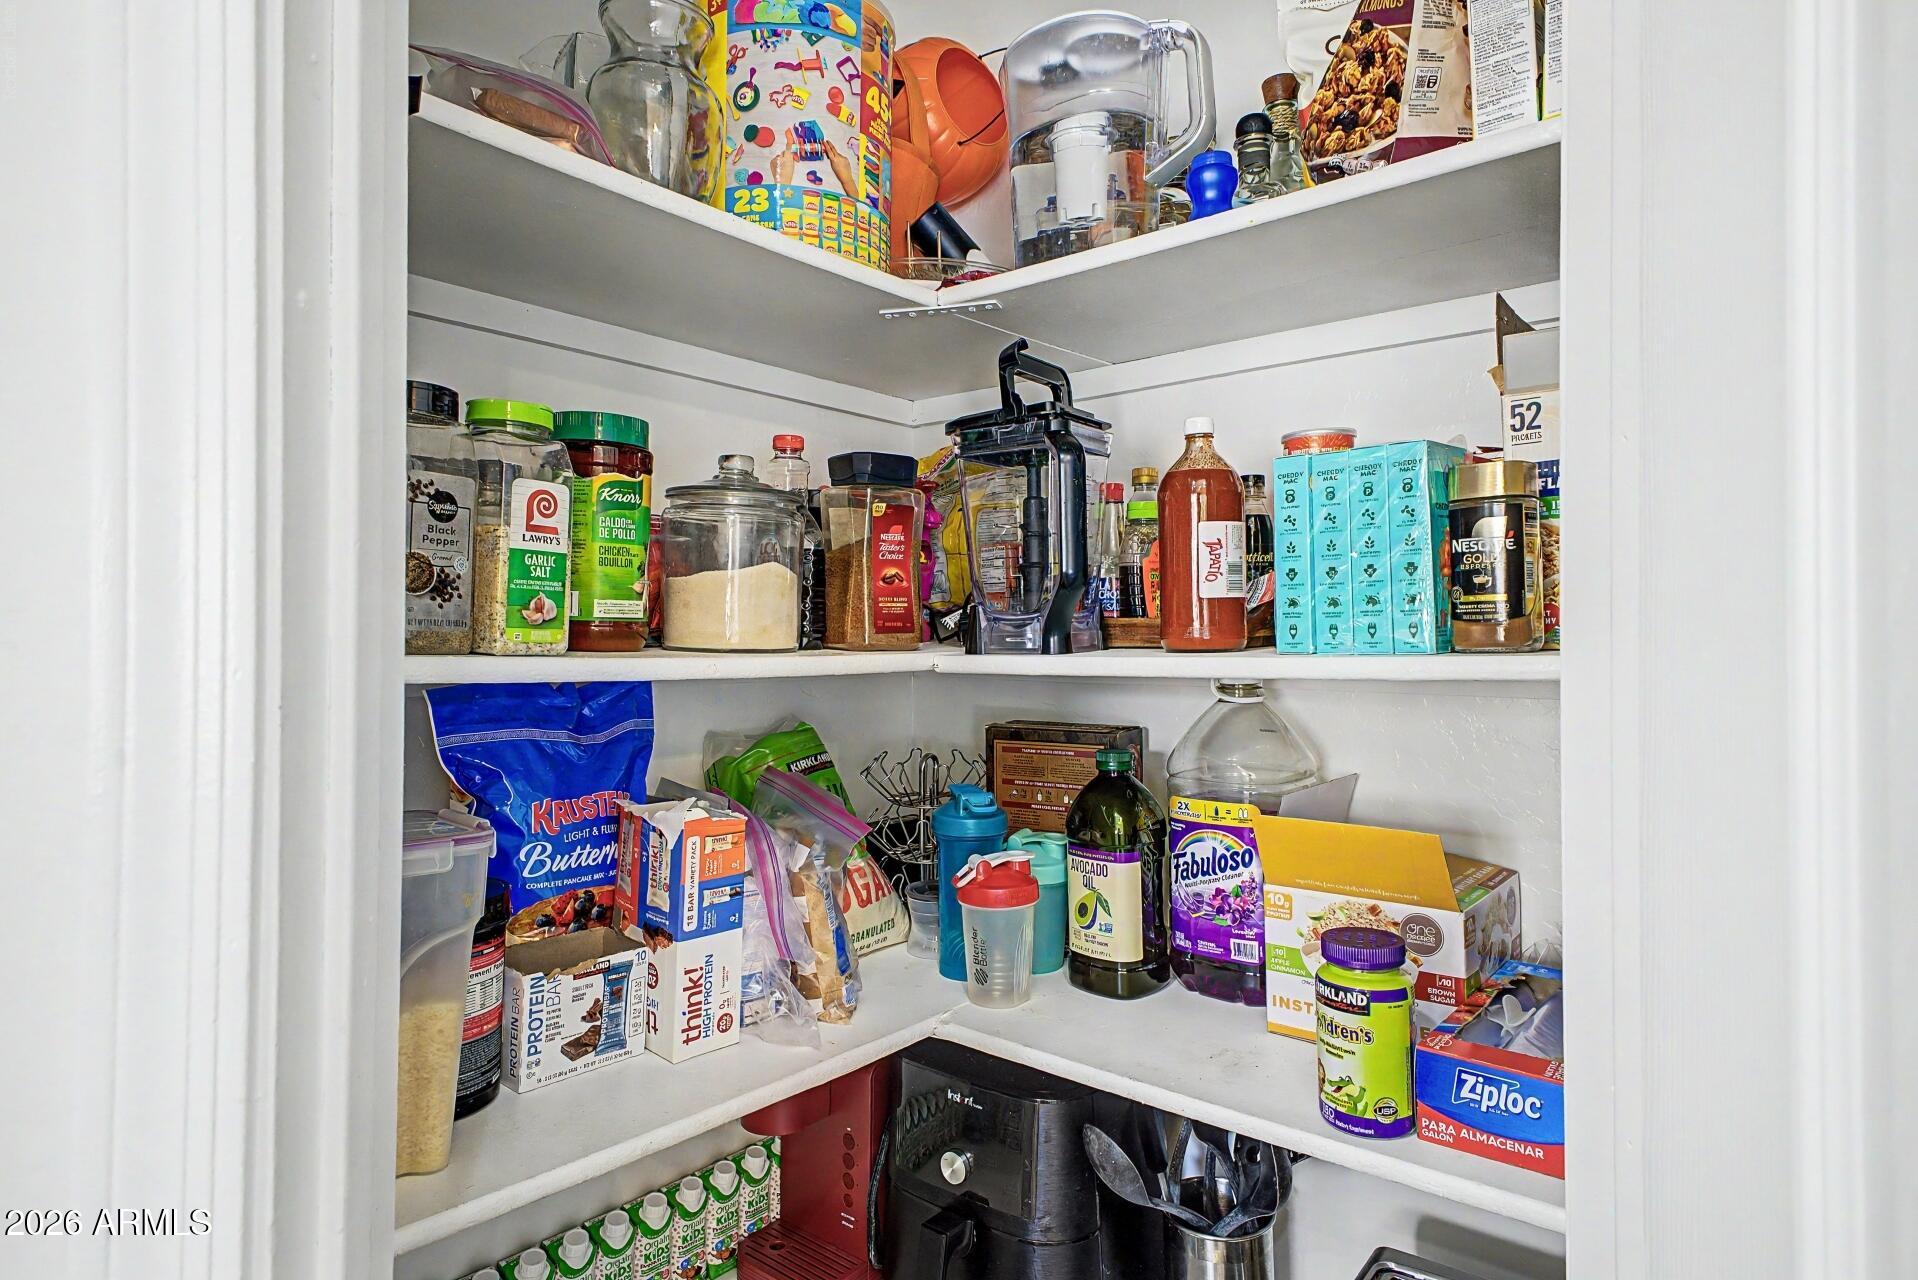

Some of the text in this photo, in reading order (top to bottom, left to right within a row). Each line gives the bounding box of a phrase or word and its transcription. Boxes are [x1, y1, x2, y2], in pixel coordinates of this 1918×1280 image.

[734, 187, 770, 214] 23
[1509, 401, 1542, 433] 52
[599, 487, 641, 504] Knorr
[427, 524, 457, 536] Black
[599, 528, 636, 540] DE POLLO
[422, 534, 460, 548] Pepper
[522, 533, 561, 546] LAWRY'S
[598, 545, 630, 557] CHICKEN
[1463, 552, 1501, 564] GOLD
[524, 553, 556, 567] GARLIC
[598, 556, 633, 569] BOUILLON
[530, 565, 551, 578] SALT
[1177, 801, 1190, 811] 2X
[563, 828, 591, 843] LIGHT
[592, 826, 599, 836] &
[690, 840, 698, 859] PACK
[1070, 857, 1109, 878] AVOCADO
[1172, 846, 1255, 885] Fabuloso
[525, 879, 563, 890] COMPLETE
[689, 862, 697, 891] VARIETY
[1082, 874, 1097, 890] OIL
[687, 892, 695, 912] BAR
[972, 926, 980, 965] Blender
[634, 950, 647, 961] 10
[1271, 964, 1306, 976] CINNAMON
[702, 953, 714, 1039] HIGH PROTEIN
[1427, 987, 1456, 998] BROWN
[1430, 994, 1456, 1005] SUGAR
[681, 966, 704, 1046] think!
[1272, 994, 1314, 1015] INST
[527, 974, 546, 1058] PROTEIN
[509, 986, 521, 1079] PROTEIN BAR
[1459, 1072, 1542, 1120] Ziploc
[1376, 1107, 1397, 1115] USP
[1421, 1117, 1545, 1160] PARA ALMACENAR
